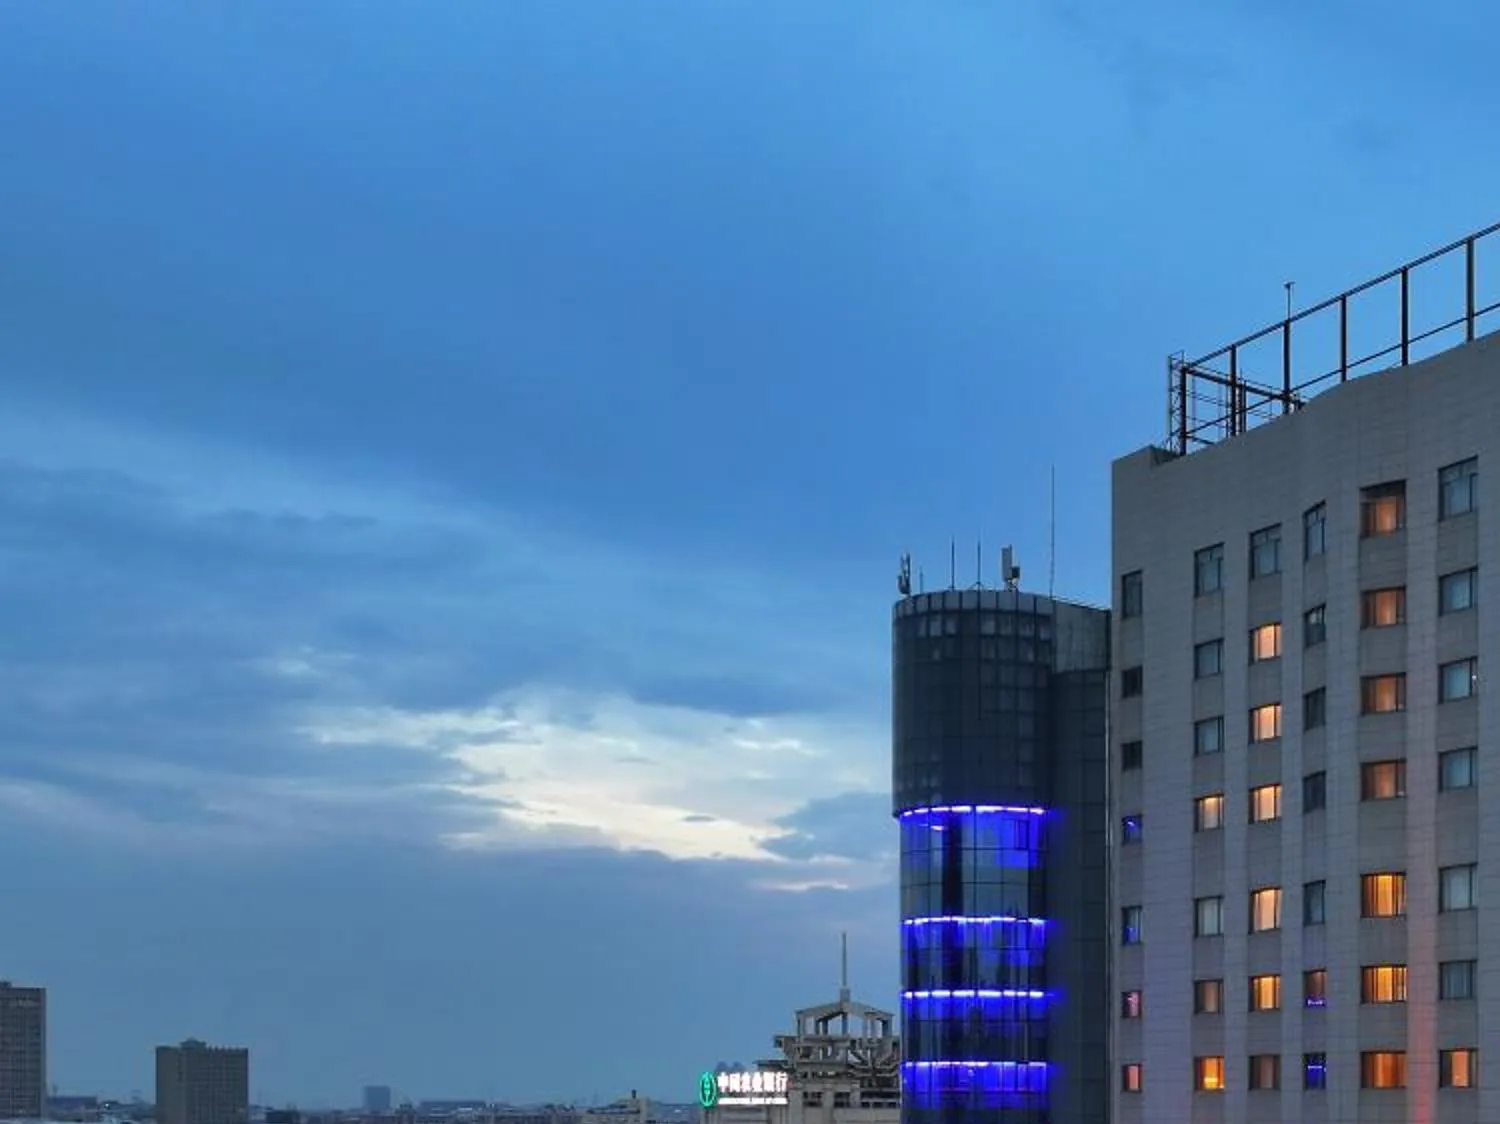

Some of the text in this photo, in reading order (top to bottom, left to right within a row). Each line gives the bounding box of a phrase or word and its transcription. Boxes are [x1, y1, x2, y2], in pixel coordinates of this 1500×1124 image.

[717, 1071, 788, 1092] 中国农业银行
